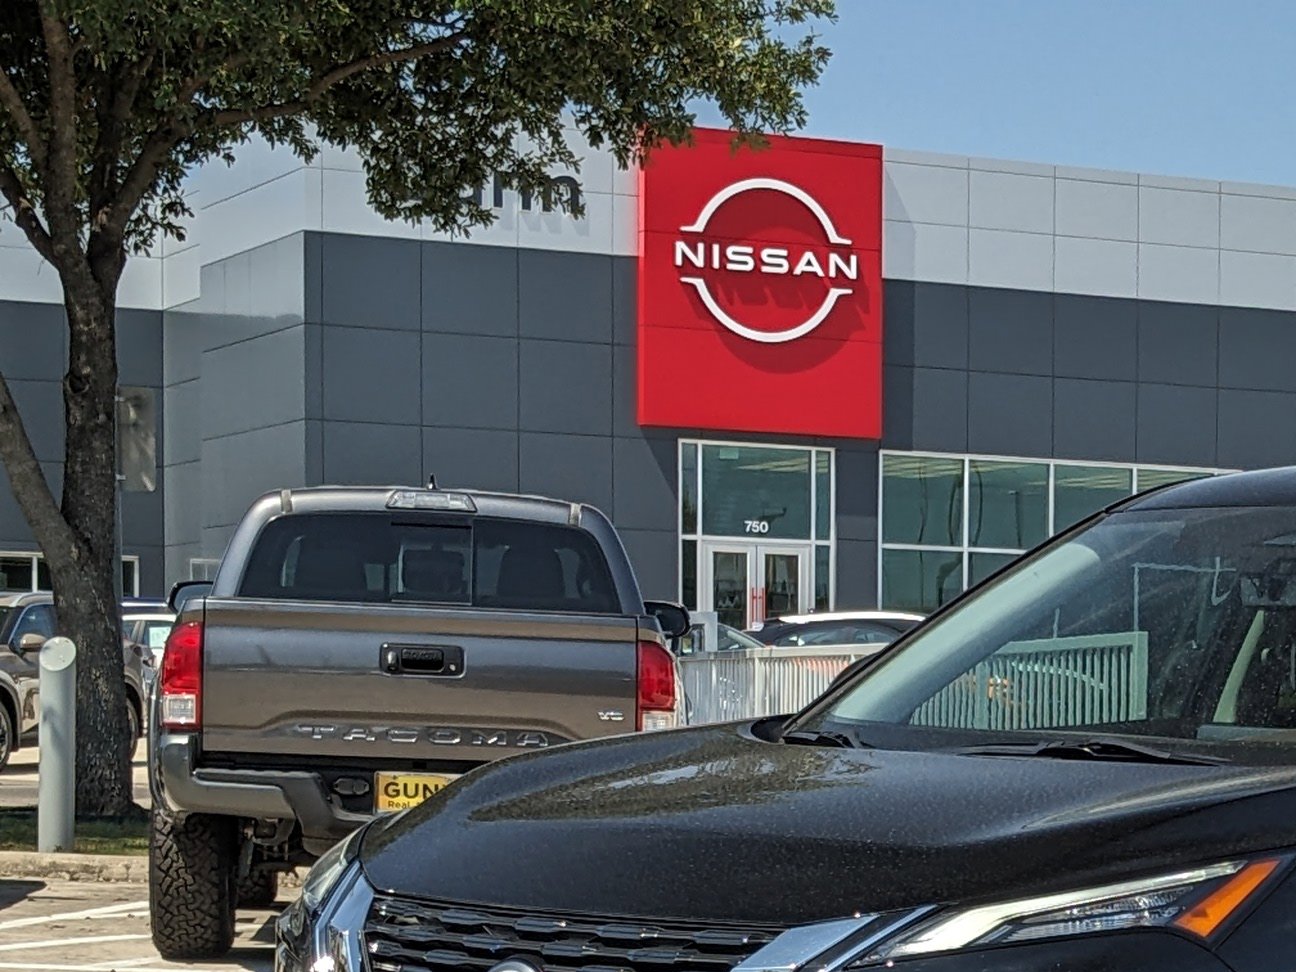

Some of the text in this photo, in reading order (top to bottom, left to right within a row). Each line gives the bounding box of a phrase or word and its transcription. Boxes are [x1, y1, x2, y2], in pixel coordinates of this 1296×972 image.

[674, 240, 858, 280] NISSAN
[743, 520, 769, 533] 750
[296, 723, 551, 748] TACOMA
[384, 781, 445, 799] GUN
[387, 801, 410, 809] Real
